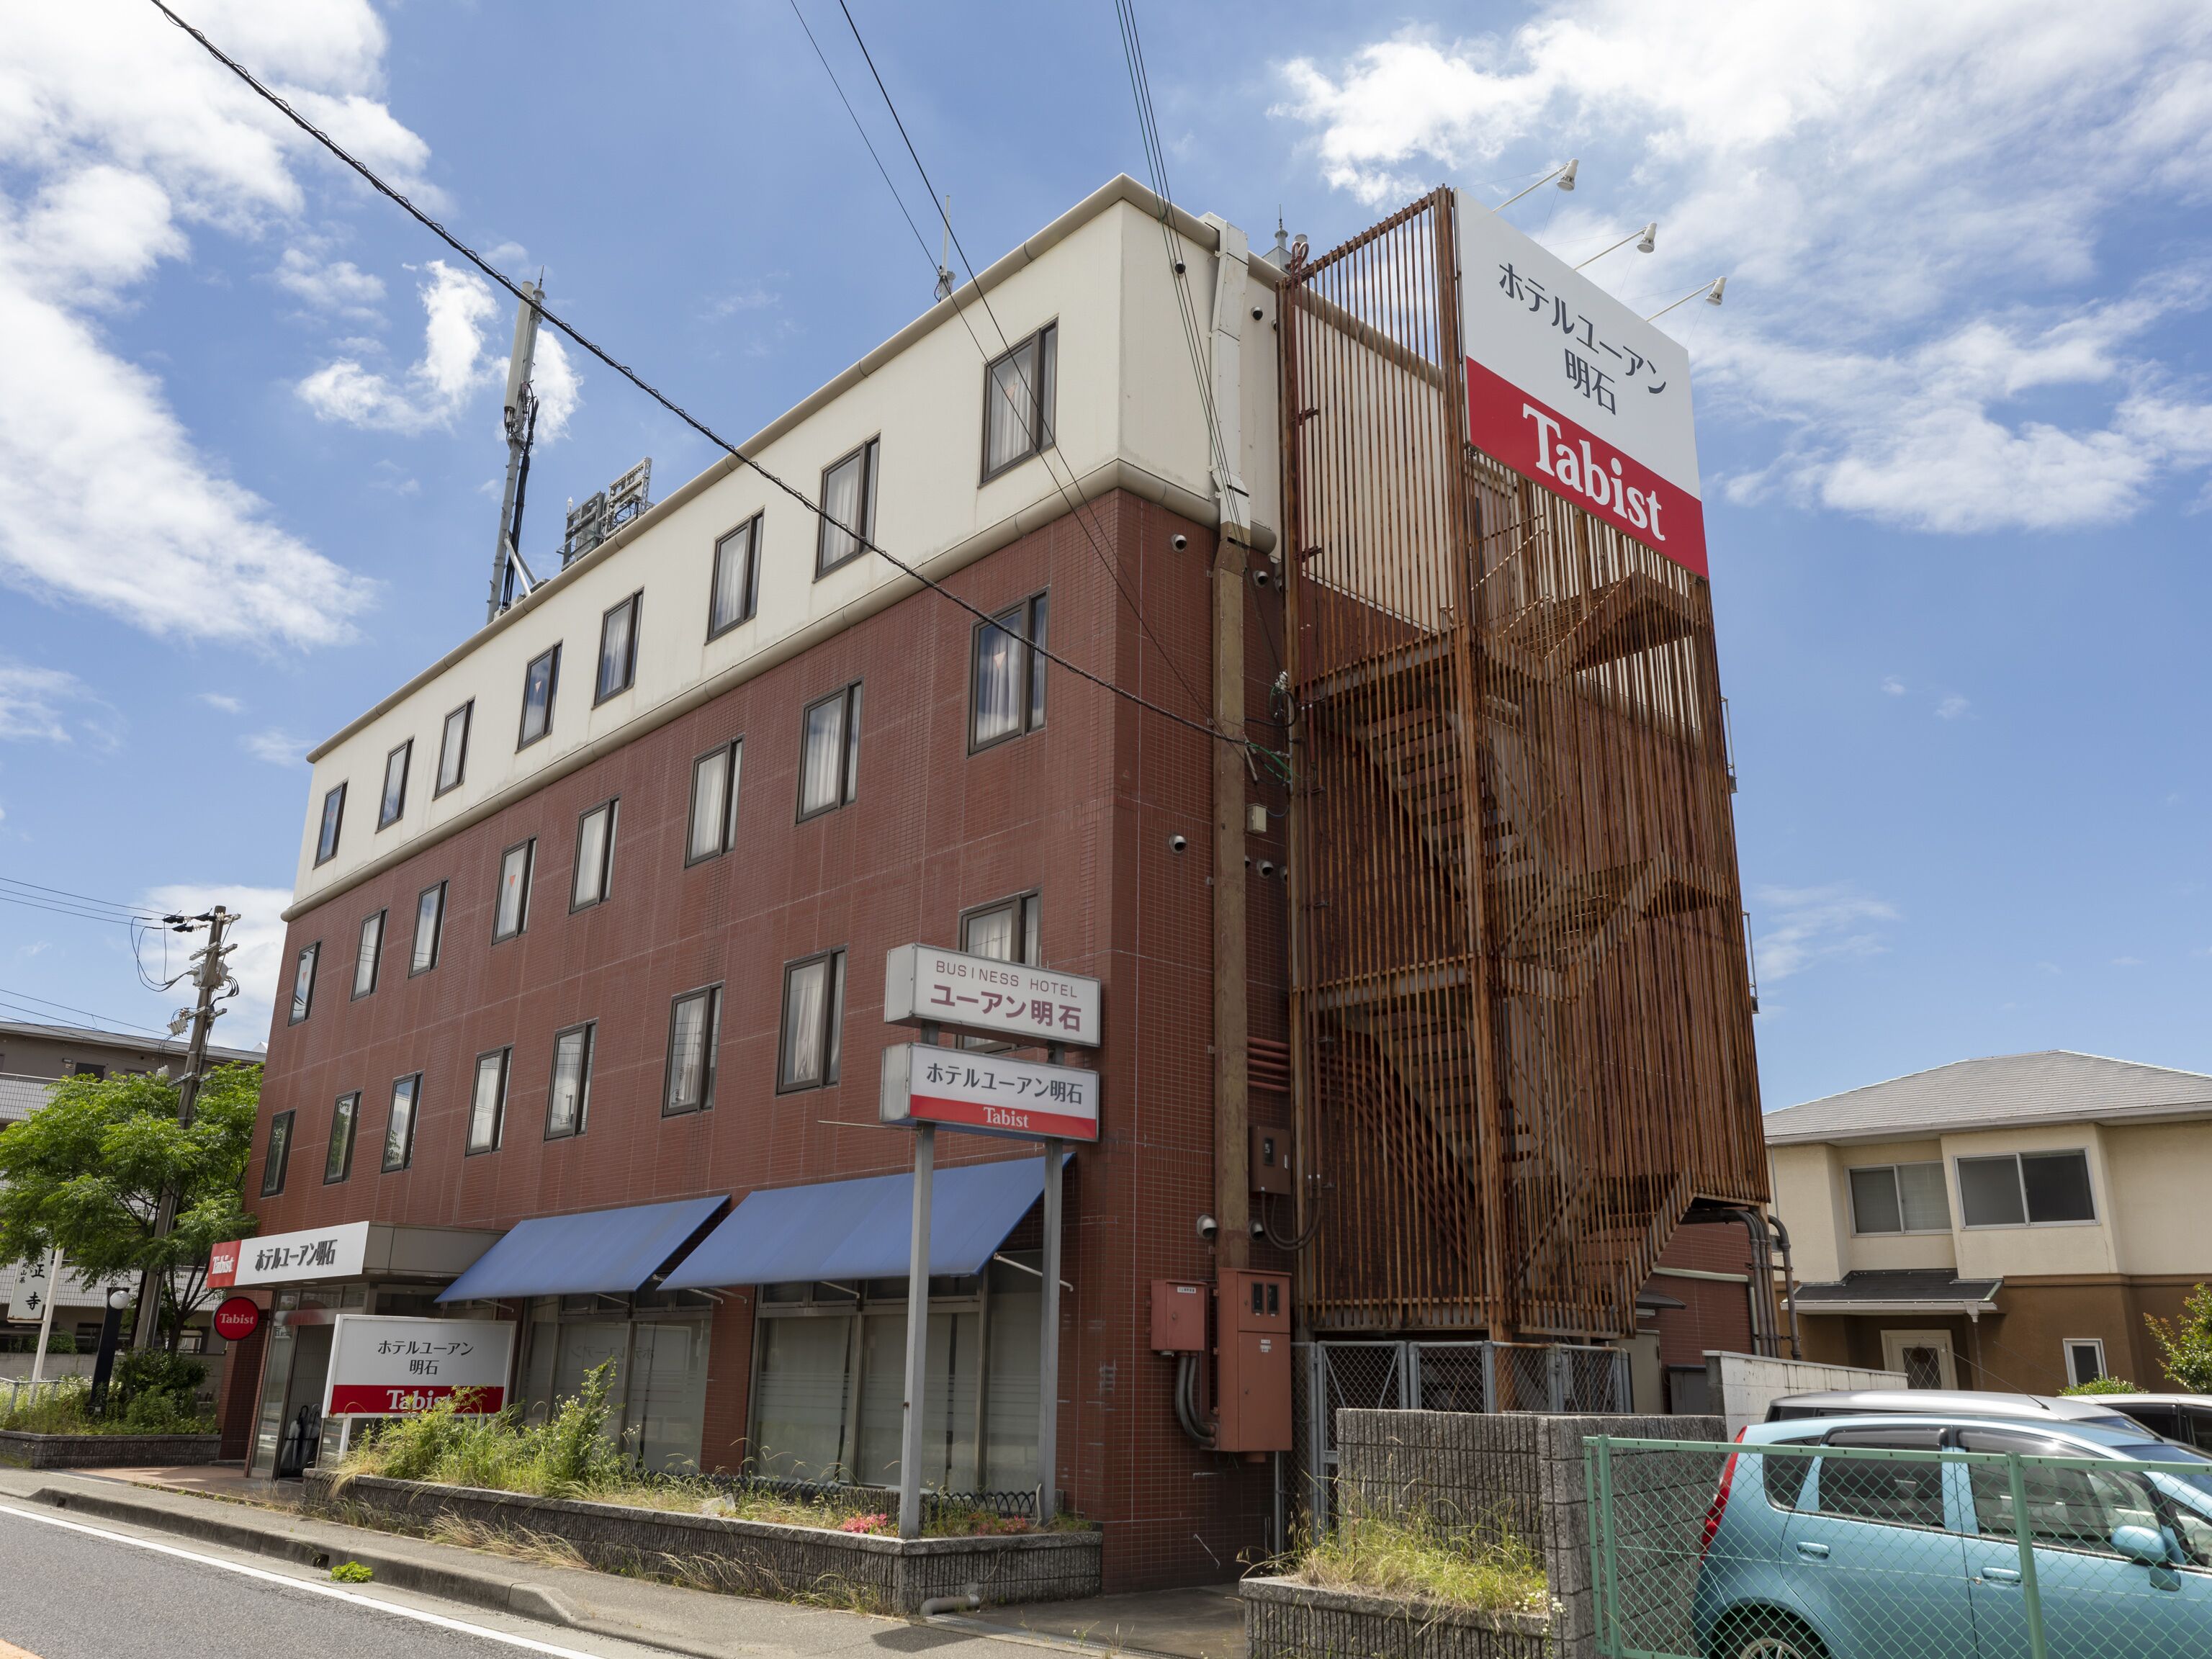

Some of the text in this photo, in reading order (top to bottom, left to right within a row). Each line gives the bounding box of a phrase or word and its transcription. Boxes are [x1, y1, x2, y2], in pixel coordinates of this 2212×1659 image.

[1498, 262, 1667, 395] ホテルユーアン
[1564, 348, 1617, 415] 明石
[1522, 403, 1666, 541] Tabist
[936, 961, 1078, 998] BUSINESS HOTEL
[930, 984, 1082, 1032] ユーアン明石
[926, 1063, 1083, 1105] ホテルユーアン明石
[983, 1106, 1029, 1128] Tabist
[212, 1254, 234, 1274] Tabist
[255, 1238, 338, 1272] ホテルユーアン明石
[220, 1313, 254, 1324] Tabist
[377, 1340, 474, 1356] ホテルユーアン
[409, 1359, 439, 1375] 明石
